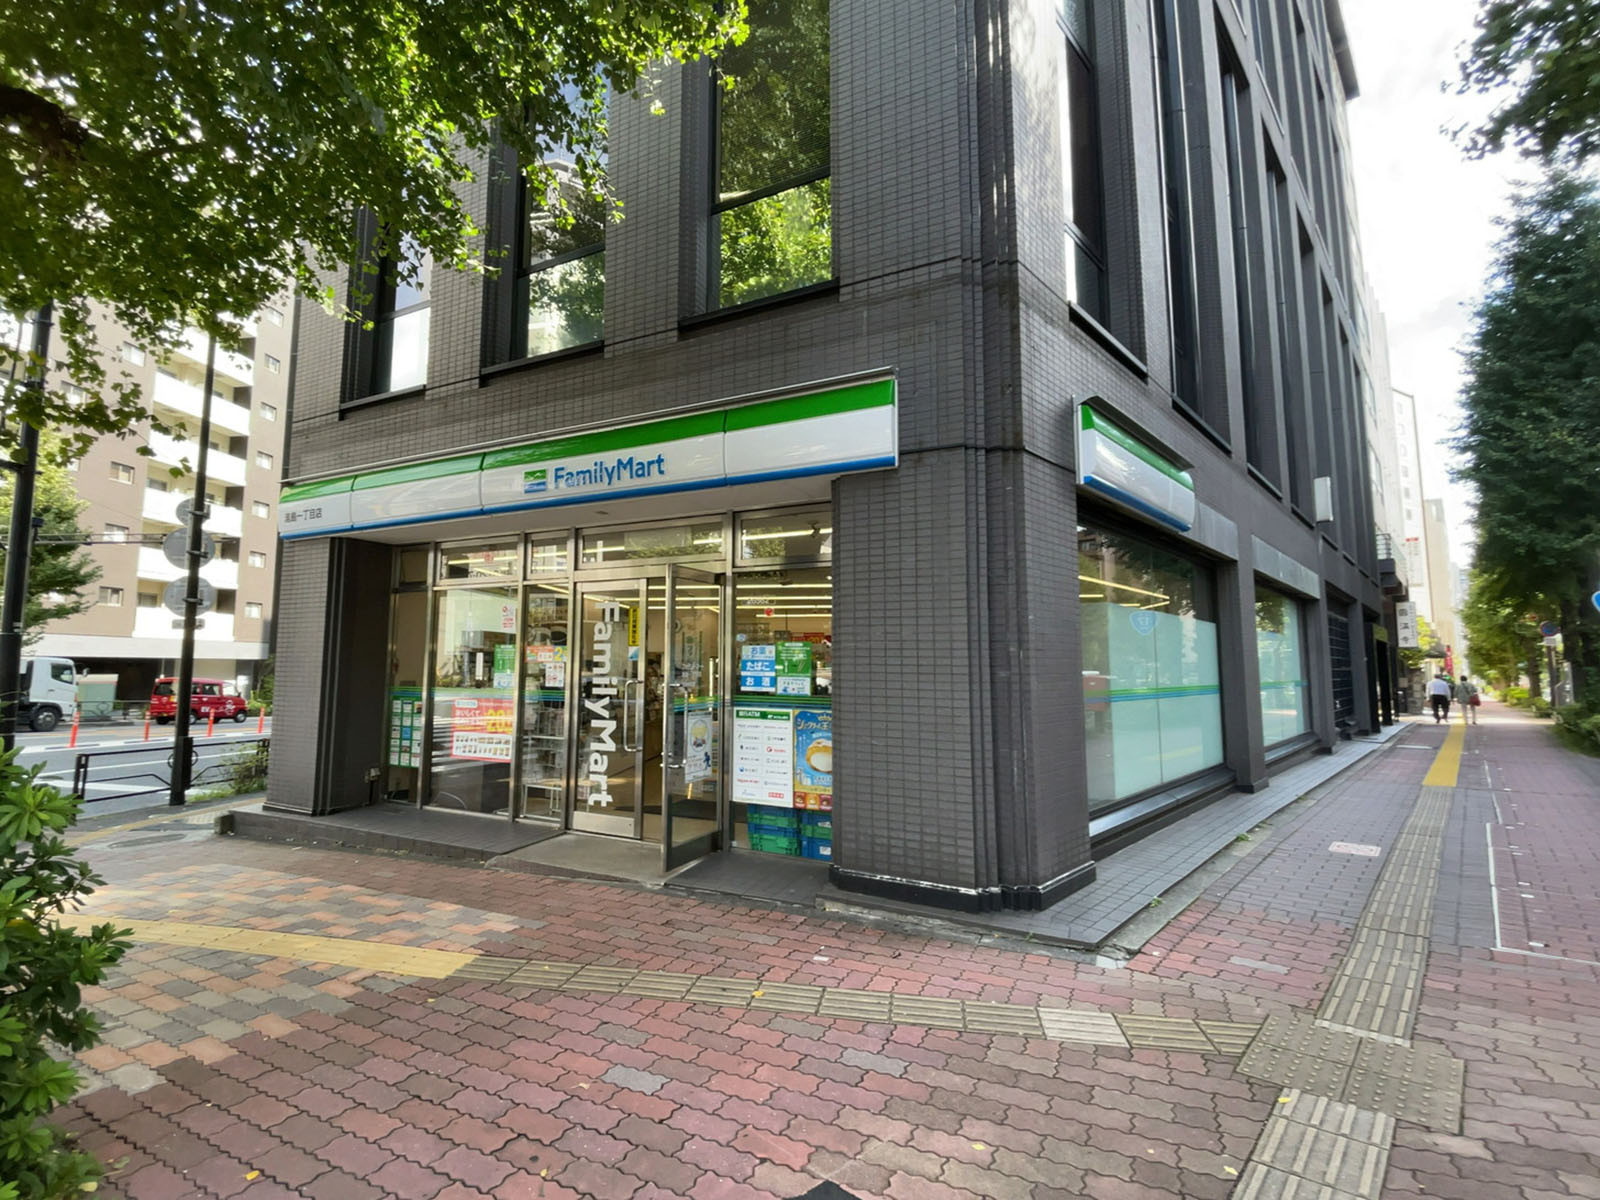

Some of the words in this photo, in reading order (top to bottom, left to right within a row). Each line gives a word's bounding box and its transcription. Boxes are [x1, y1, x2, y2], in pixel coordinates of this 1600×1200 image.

[553, 453, 665, 489] FamilyMart
[745, 661, 771, 671] たばこ
[584, 601, 620, 807] FamilyMart
